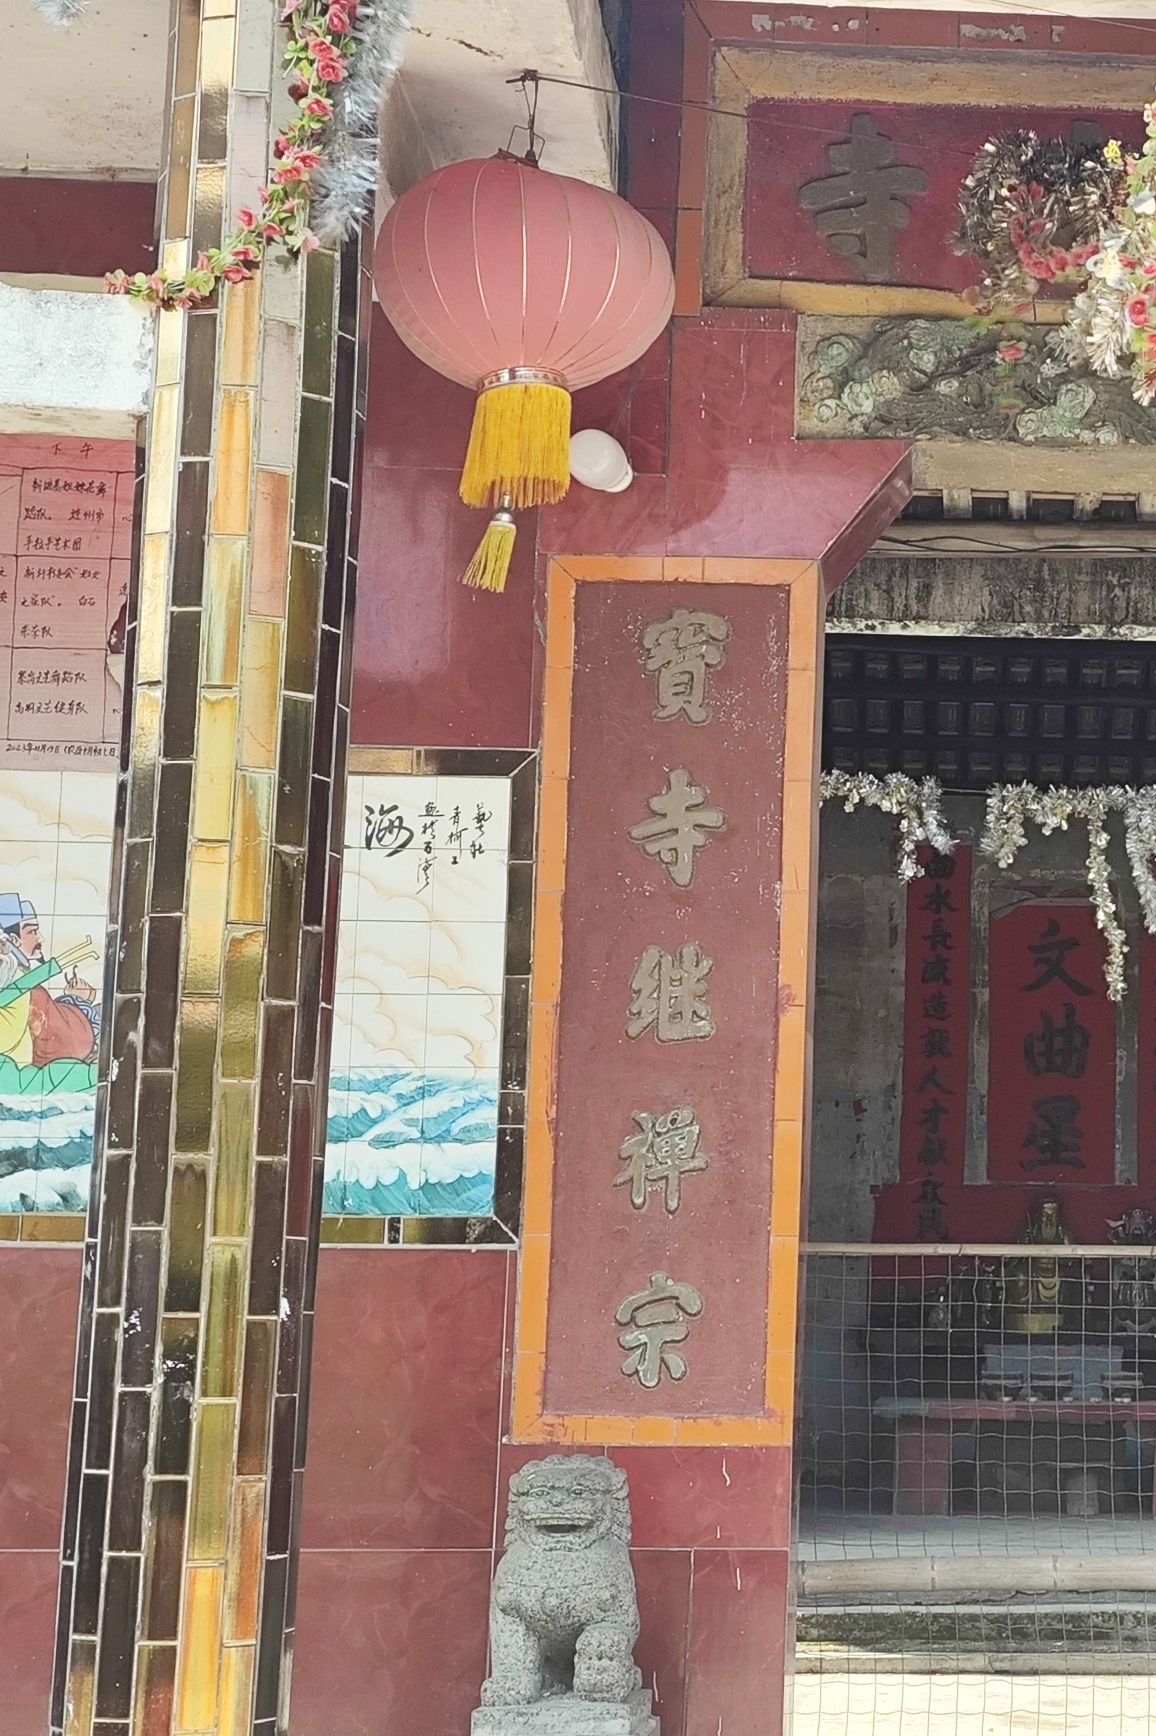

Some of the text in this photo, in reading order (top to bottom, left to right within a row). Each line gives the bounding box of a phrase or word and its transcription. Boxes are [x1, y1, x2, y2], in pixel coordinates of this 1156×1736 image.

[364, 803, 415, 858] 海
[1020, 918, 1094, 1172] 文曲星
